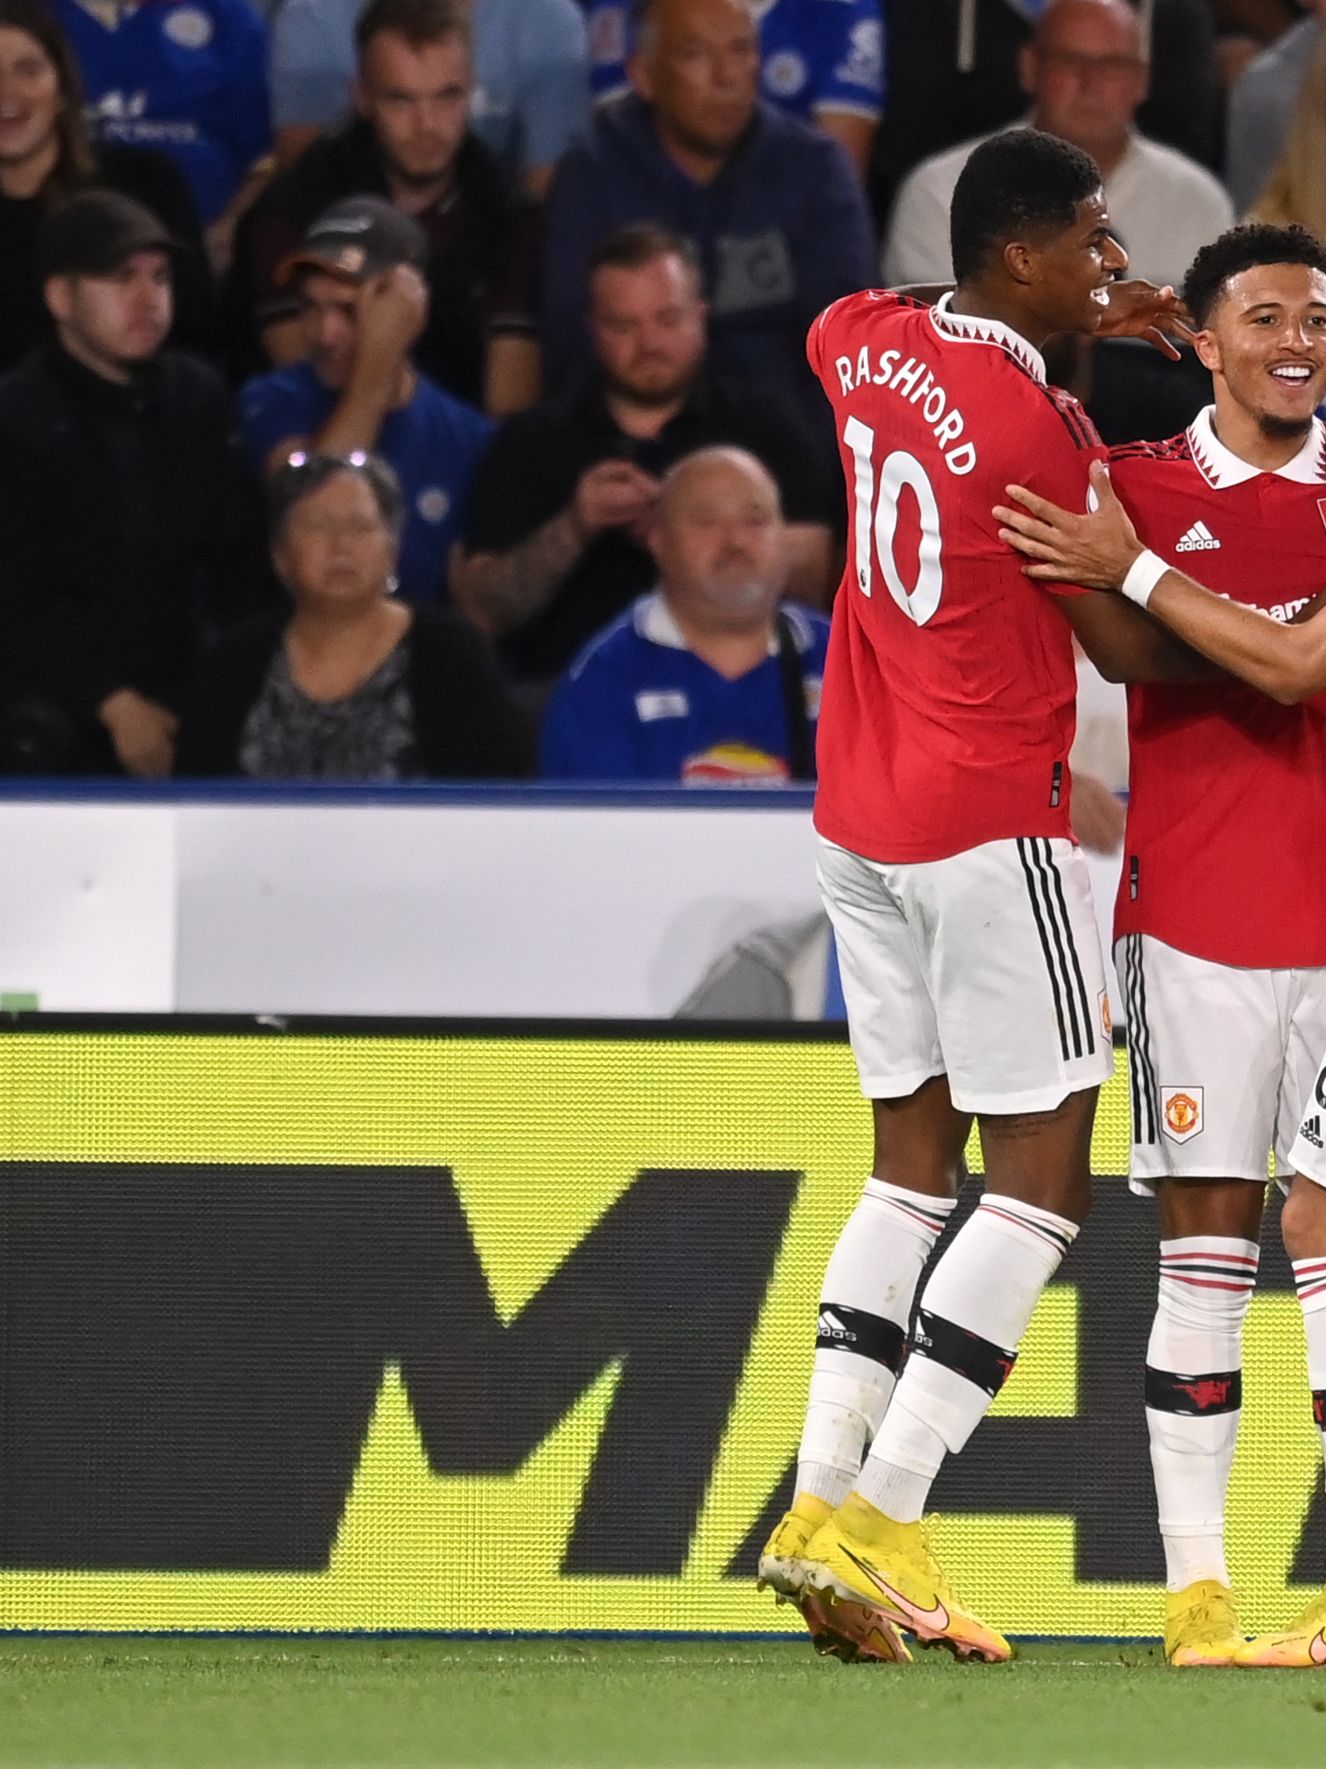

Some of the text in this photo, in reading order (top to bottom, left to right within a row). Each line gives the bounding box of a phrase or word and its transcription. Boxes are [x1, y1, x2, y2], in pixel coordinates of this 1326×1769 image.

[835, 346, 977, 476] RASHFORD
[843, 415, 943, 627] 10
[1175, 538, 1221, 552] adidas
